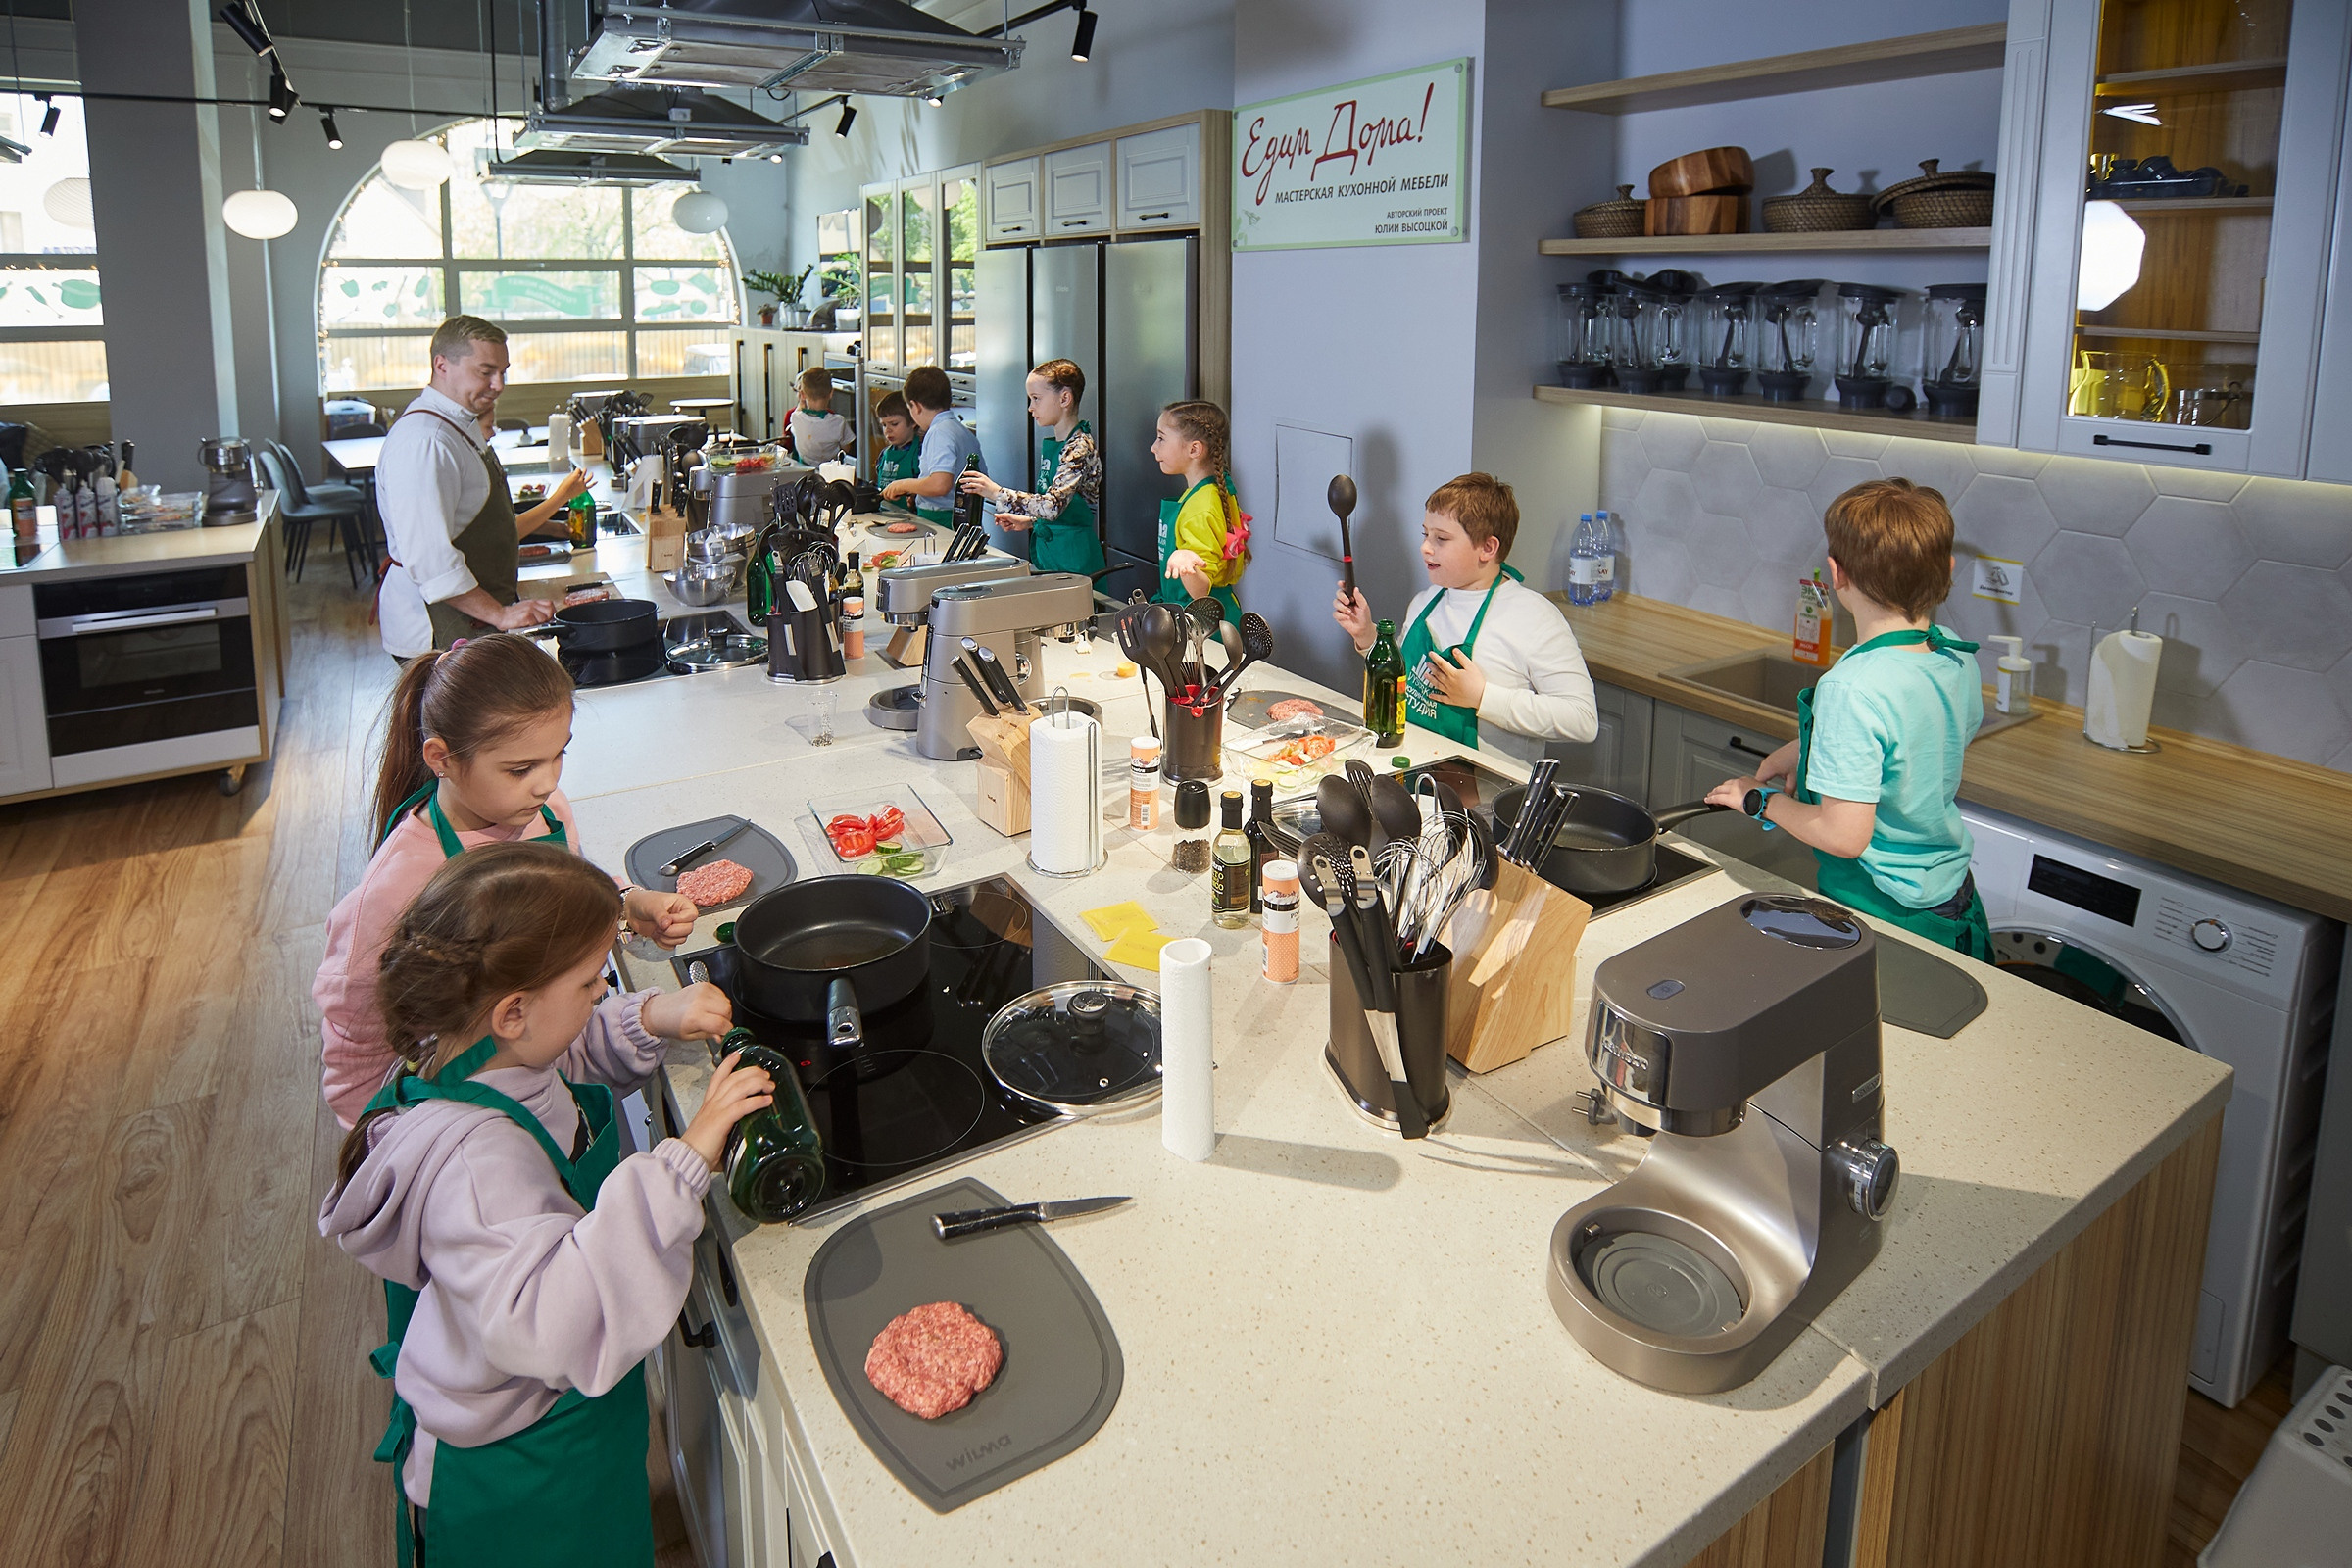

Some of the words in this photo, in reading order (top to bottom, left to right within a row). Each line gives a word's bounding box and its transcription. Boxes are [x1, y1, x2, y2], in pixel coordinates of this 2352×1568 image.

[1242, 116, 1312, 206] Едим
[1310, 82, 1435, 181] Дома!
[1275, 185, 1334, 204] МАСТЕРСКАЯ
[1338, 176, 1396, 198] КУХОННОЙ
[1400, 173, 1449, 192] МЕБЕЛИ
[1387, 208, 1422, 219] АВТОРСКИЙ
[1423, 207, 1448, 217] ПРОЕКТ
[1375, 222, 1399, 234] ЮЛИИ
[1401, 219, 1448, 233] ВЫСОЦКОЙ
